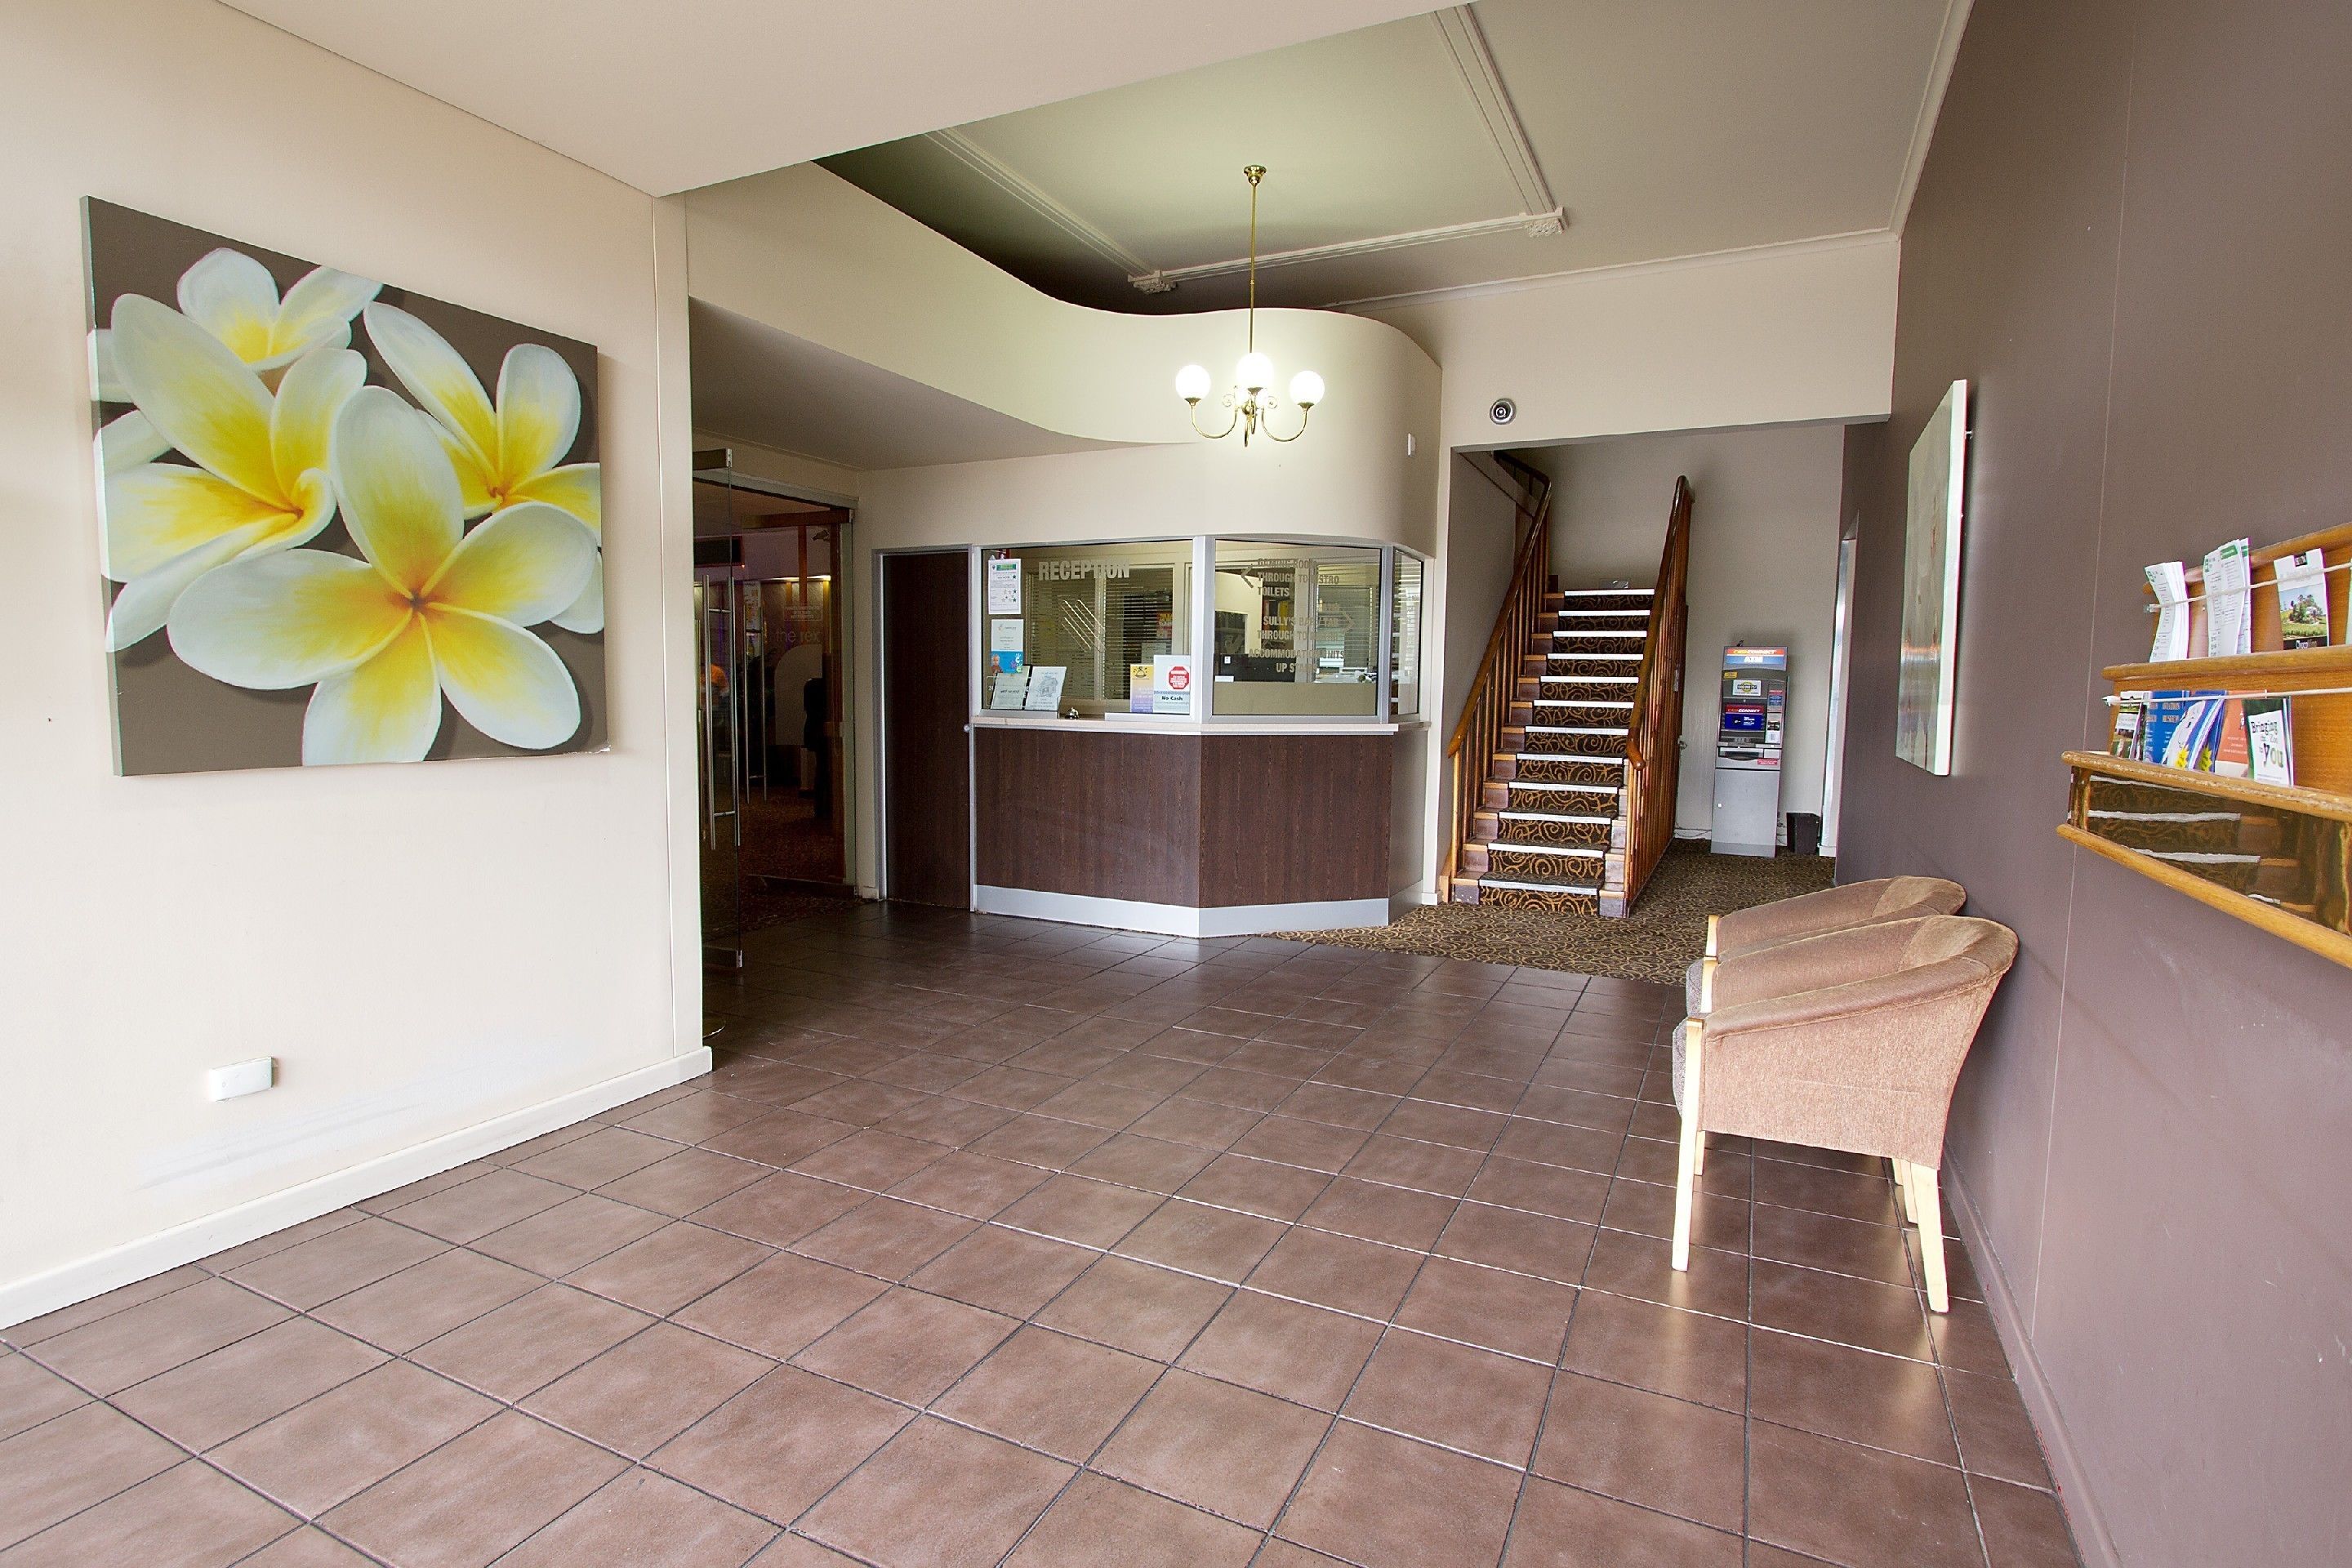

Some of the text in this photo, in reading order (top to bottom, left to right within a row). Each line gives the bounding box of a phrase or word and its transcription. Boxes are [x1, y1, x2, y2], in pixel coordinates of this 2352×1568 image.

[1038, 560, 1129, 581] RECEPTION
[1258, 572, 1339, 584] THROUGH TO STRO
[1258, 587, 1290, 597] TOILETS
[1263, 616, 1295, 626] SULLY'S
[1258, 630, 1295, 640] THROUGH
[1297, 631, 1307, 640] TO
[1276, 663, 1287, 673] UP
[2251, 720, 2278, 736] Bringing
[2263, 743, 2284, 768] you
